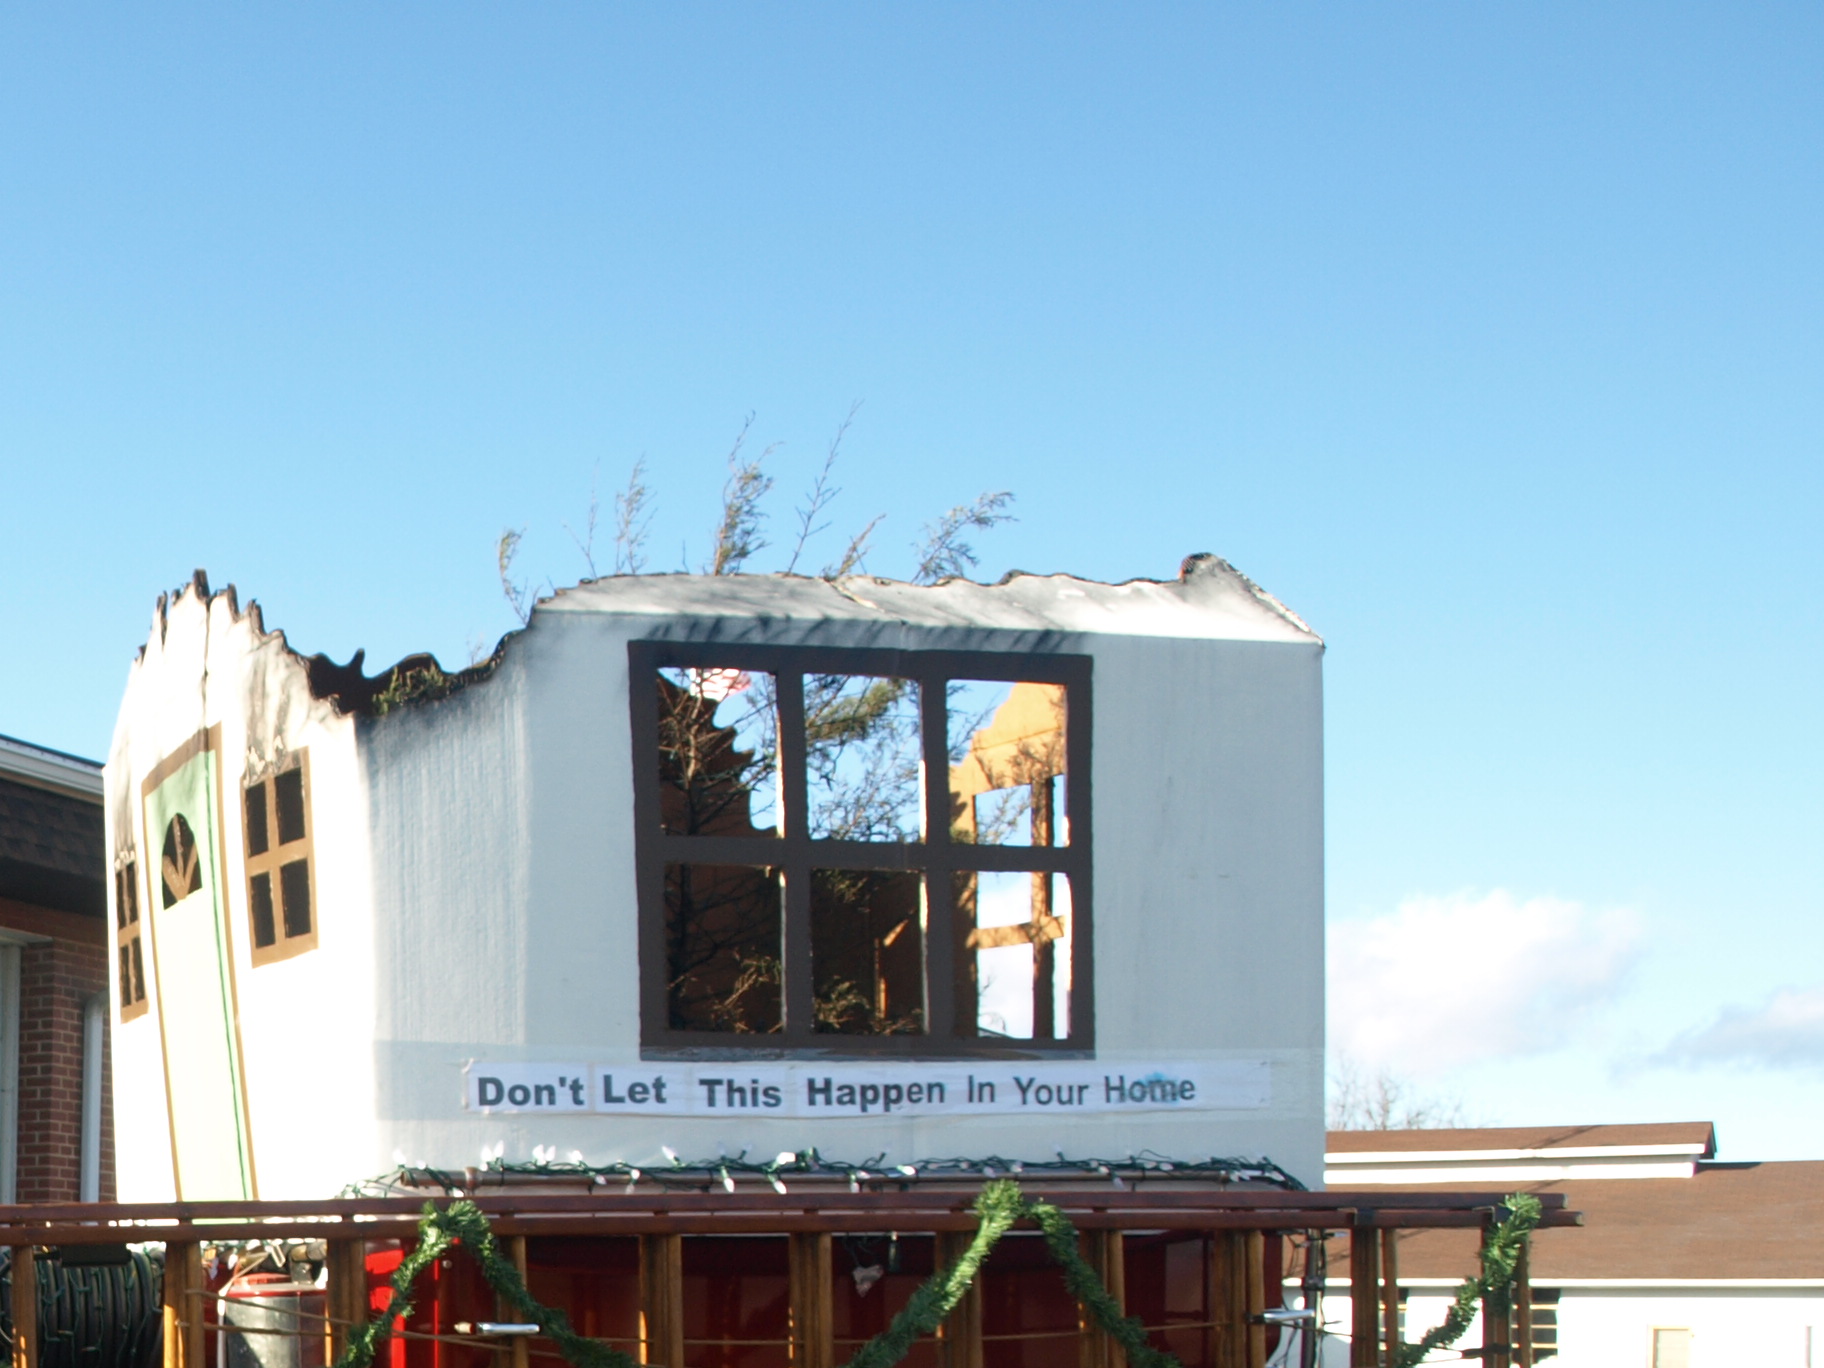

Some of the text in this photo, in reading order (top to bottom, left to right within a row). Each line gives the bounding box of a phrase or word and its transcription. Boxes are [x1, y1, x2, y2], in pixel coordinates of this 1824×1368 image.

[477, 1074, 1196, 1113] Don't Let This Happen In Your Home
